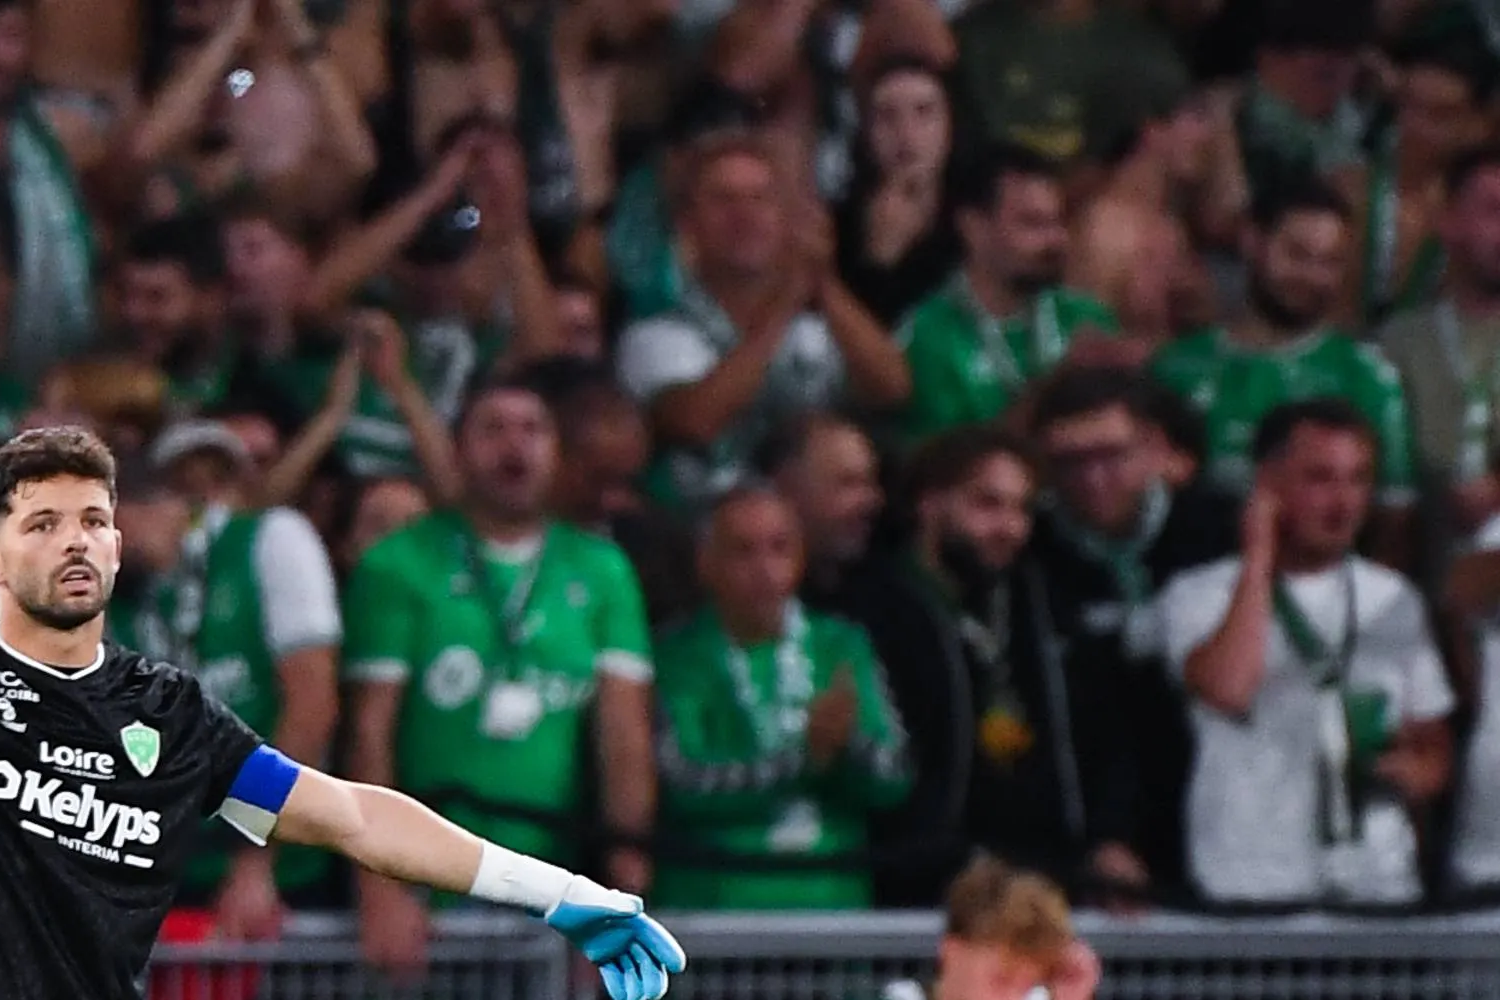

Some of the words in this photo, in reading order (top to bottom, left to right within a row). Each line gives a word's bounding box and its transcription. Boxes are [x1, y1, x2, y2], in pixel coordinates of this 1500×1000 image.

[40, 741, 115, 775] Loire
[19, 769, 161, 848] Kelyps
[57, 834, 120, 863] INTERIM
